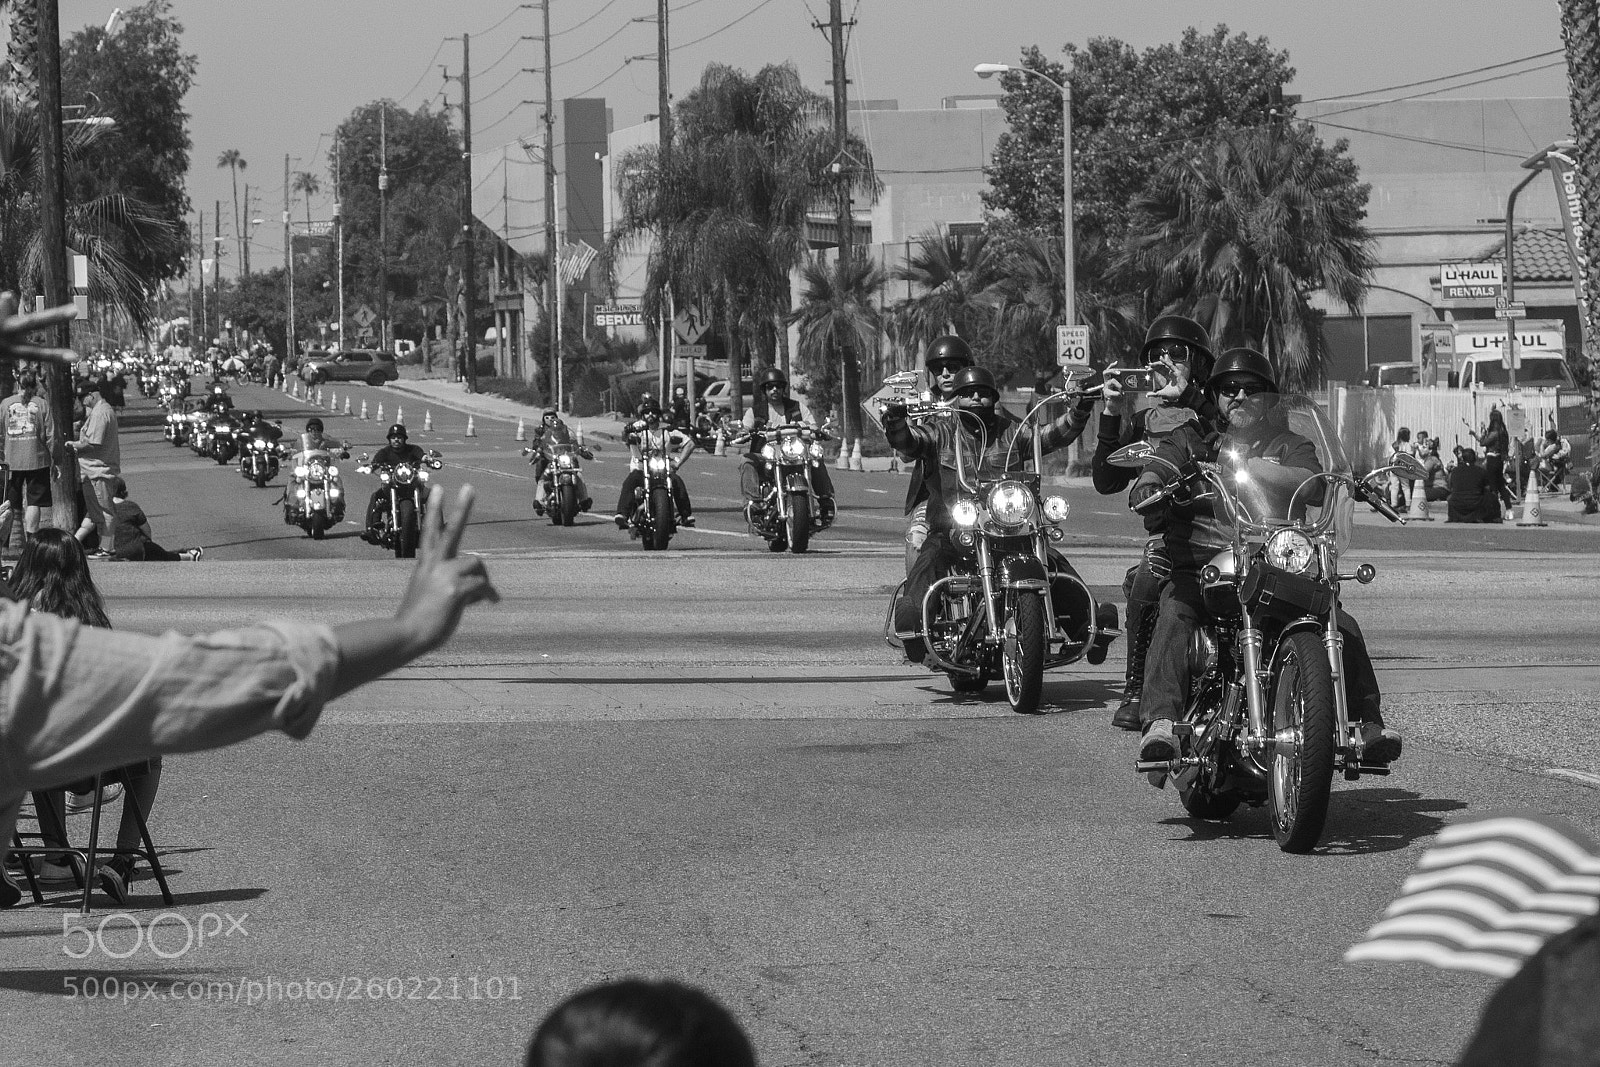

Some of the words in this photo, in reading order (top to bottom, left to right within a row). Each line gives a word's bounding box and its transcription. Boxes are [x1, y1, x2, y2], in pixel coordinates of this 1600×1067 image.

[1449, 286, 1495, 297] RENTALS
[596, 314, 645, 326] SERVIC
[1061, 330, 1085, 338] SPEED
[1472, 335, 1547, 348] U-HUL
[1061, 346, 1085, 360] 40
